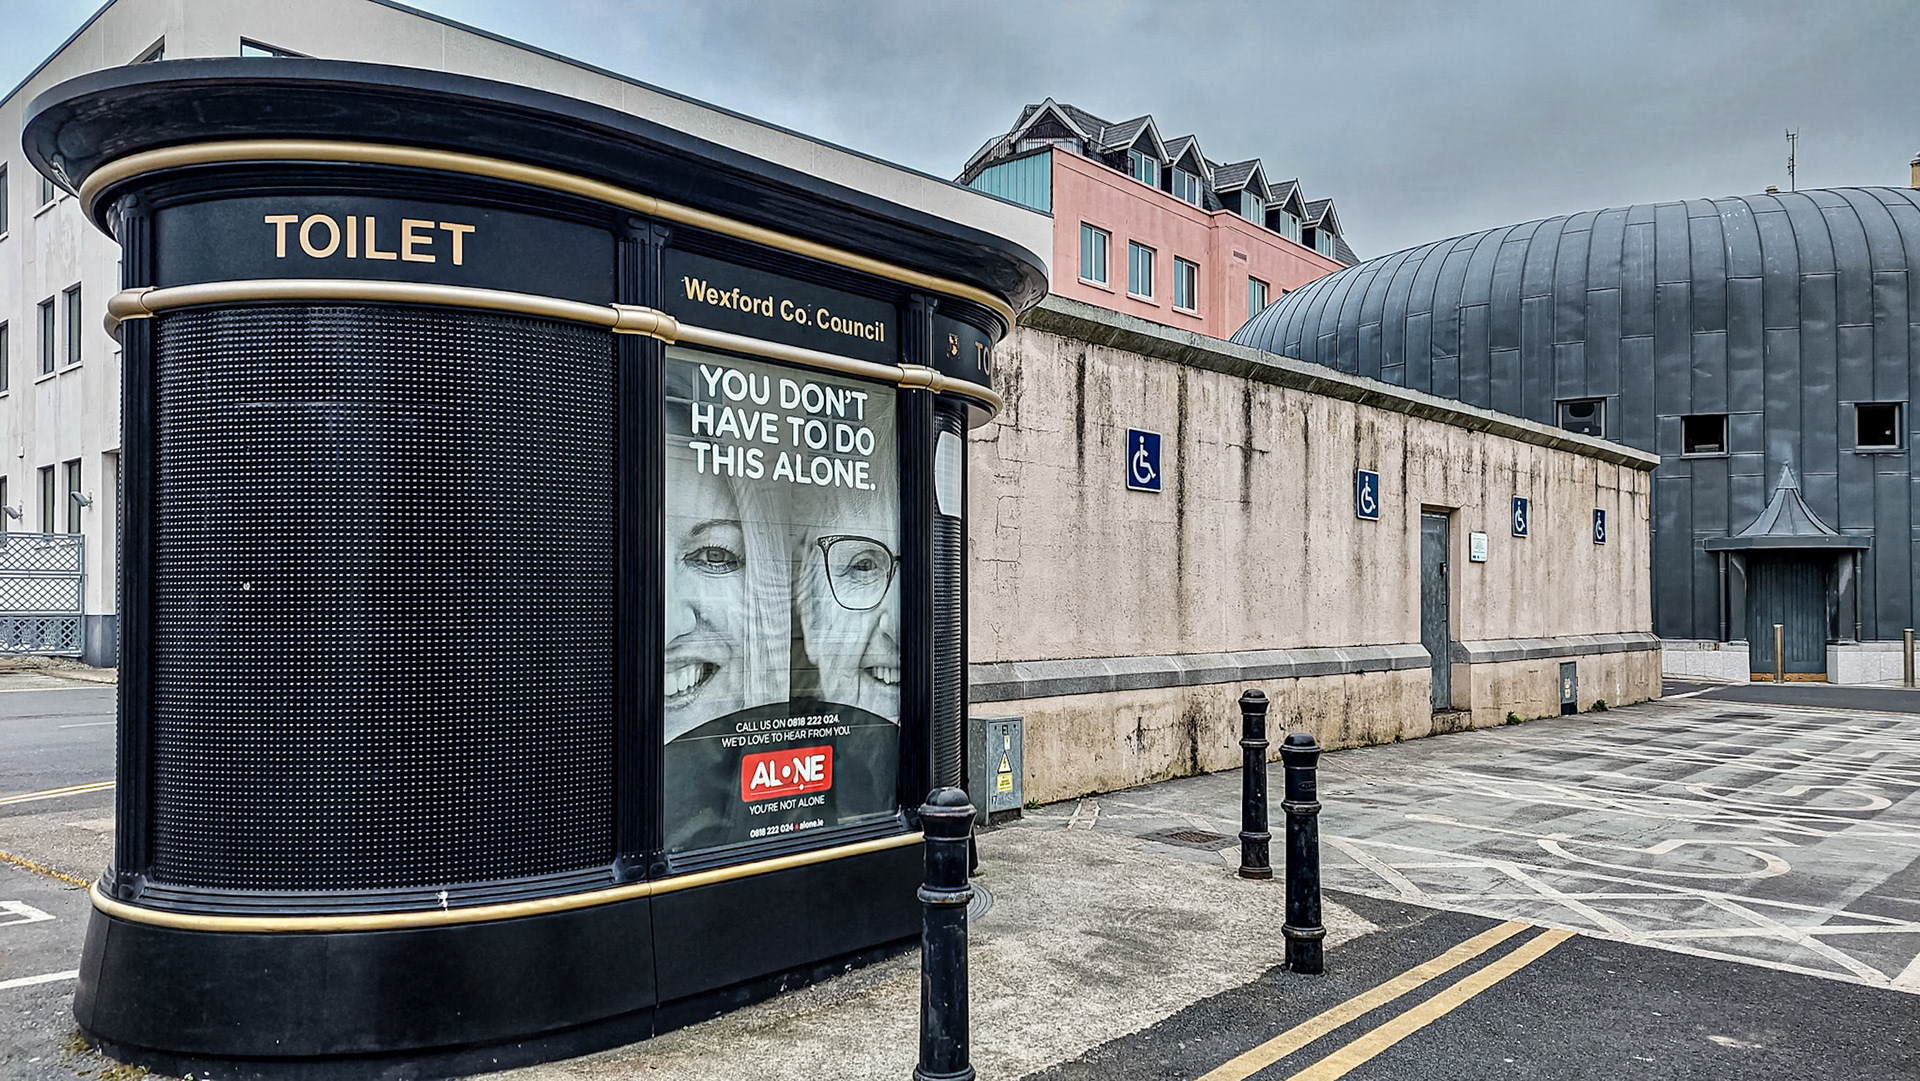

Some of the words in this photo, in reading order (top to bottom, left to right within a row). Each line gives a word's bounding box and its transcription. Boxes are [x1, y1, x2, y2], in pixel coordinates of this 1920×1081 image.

[264, 213, 477, 266] TOILET
[684, 276, 774, 318] Wexford
[780, 299, 813, 327] Co.
[815, 308, 886, 342] Council
[699, 364, 771, 406] YOU
[779, 378, 868, 421] DON'T
[691, 401, 779, 444] HAVE
[786, 416, 828, 450] TO
[835, 423, 875, 457] DO
[689, 441, 764, 480] THIS
[772, 451, 877, 492] ALONE.
[735, 720, 758, 733] CALL
[760, 719, 771, 731] US
[773, 718, 786, 730] ON
[787, 717, 805, 728] 0818
[807, 715, 822, 726] 222
[747, 734, 769, 746] LOVE
[771, 732, 783, 743] TO
[784, 730, 807, 742] HEAR
[808, 728, 833, 740] FROM
[780, 799, 797, 810] NOT
[797, 795, 825, 808] ALONE
[750, 827, 766, 838] 0818
[767, 825, 779, 836] 222
[780, 823, 794, 834] 024
[799, 819, 824, 831] alone.ie
